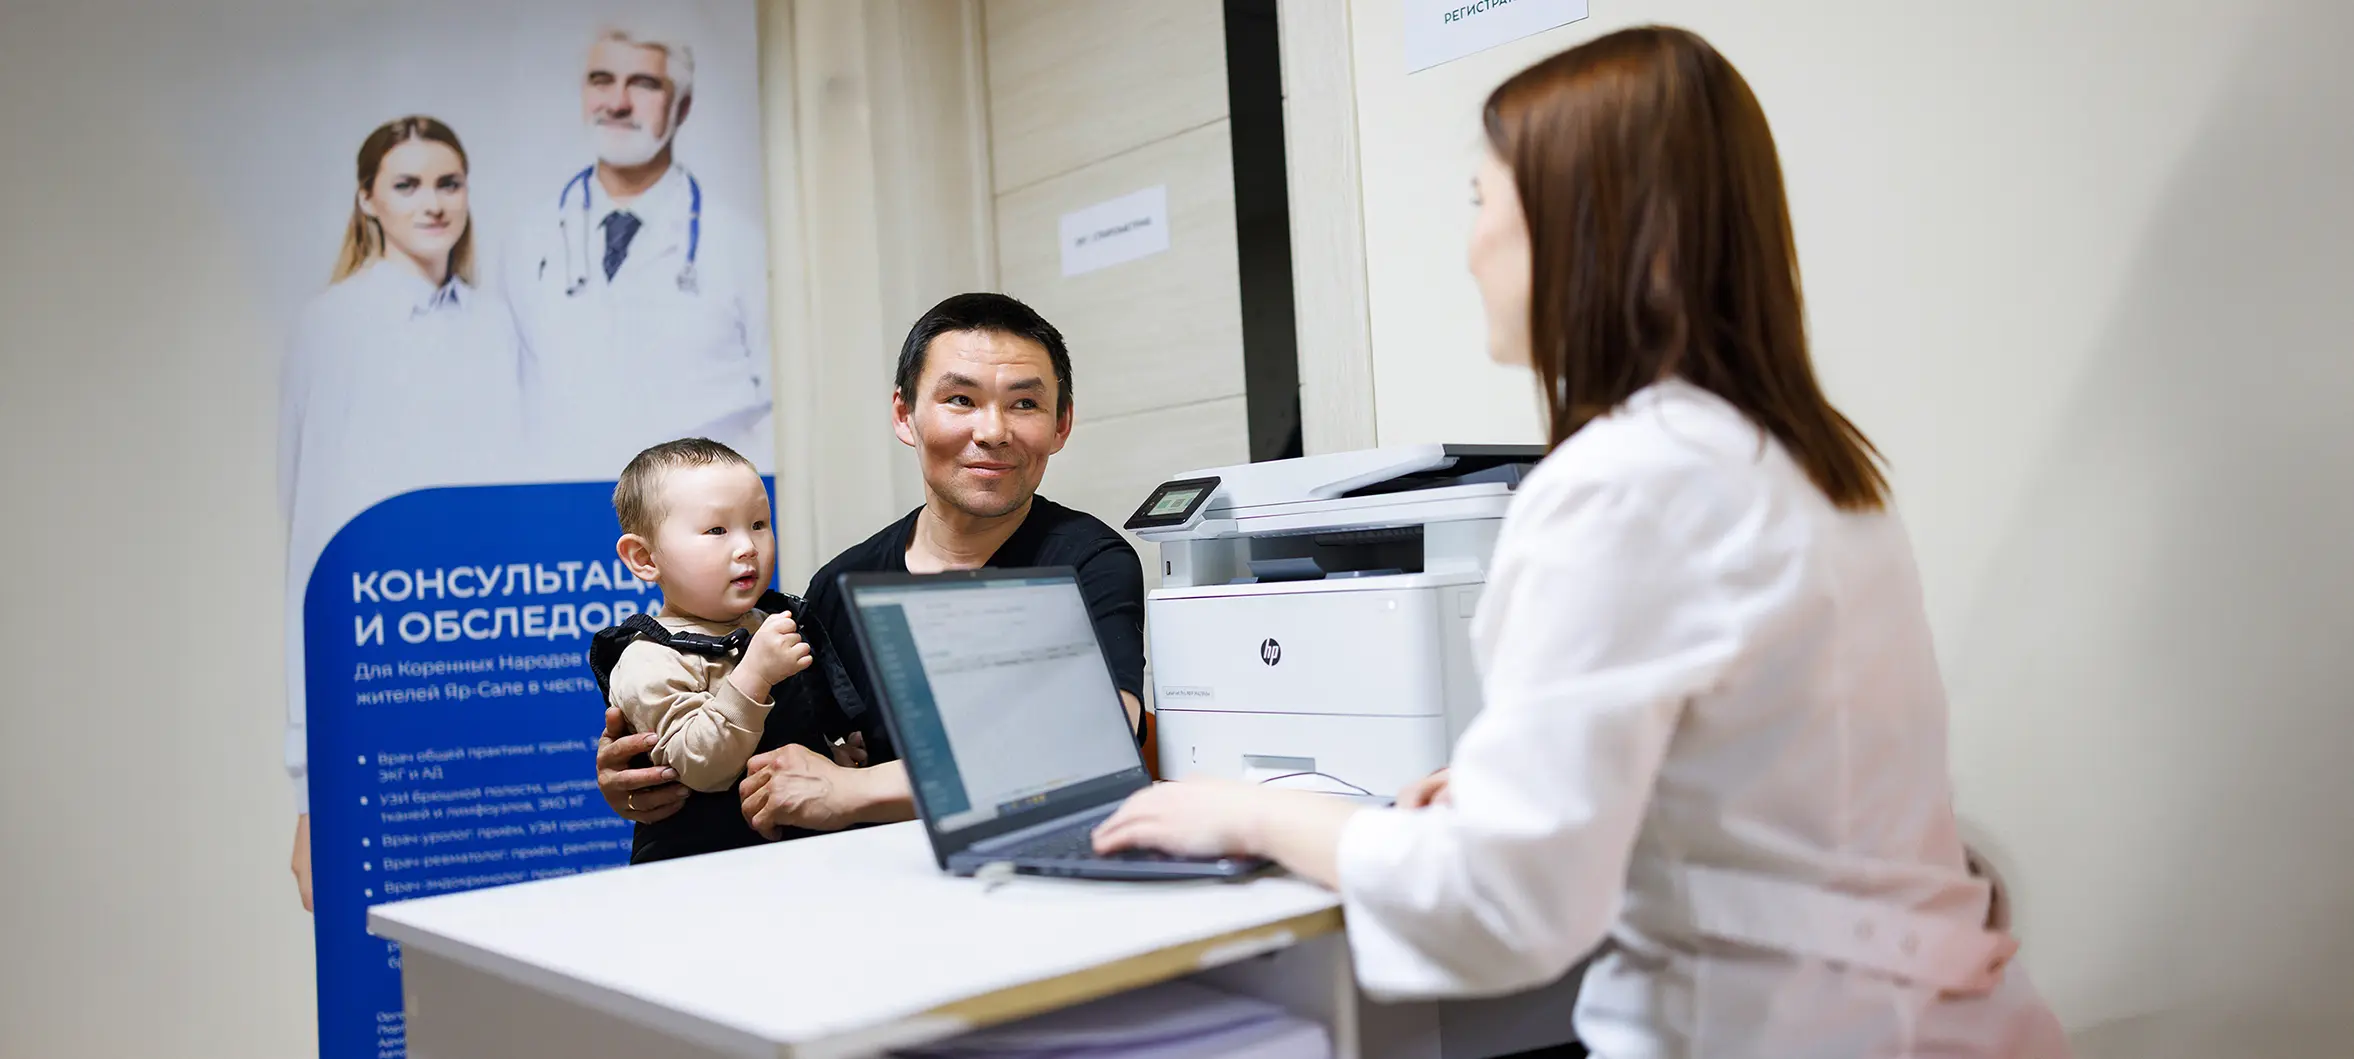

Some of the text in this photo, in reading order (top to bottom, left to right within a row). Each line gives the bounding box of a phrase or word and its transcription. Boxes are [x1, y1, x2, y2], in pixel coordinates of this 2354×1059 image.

[1444, 0, 1516, 24] РЕГИСТР
[352, 559, 655, 604] КОНСУЛЬТАЦ
[355, 614, 385, 647] И
[354, 662, 394, 682] Для
[398, 656, 495, 678] Коренных
[499, 652, 582, 672] Народов
[356, 685, 440, 705] жителей
[444, 680, 525, 702] Яр-Сале
[528, 681, 540, 695] в
